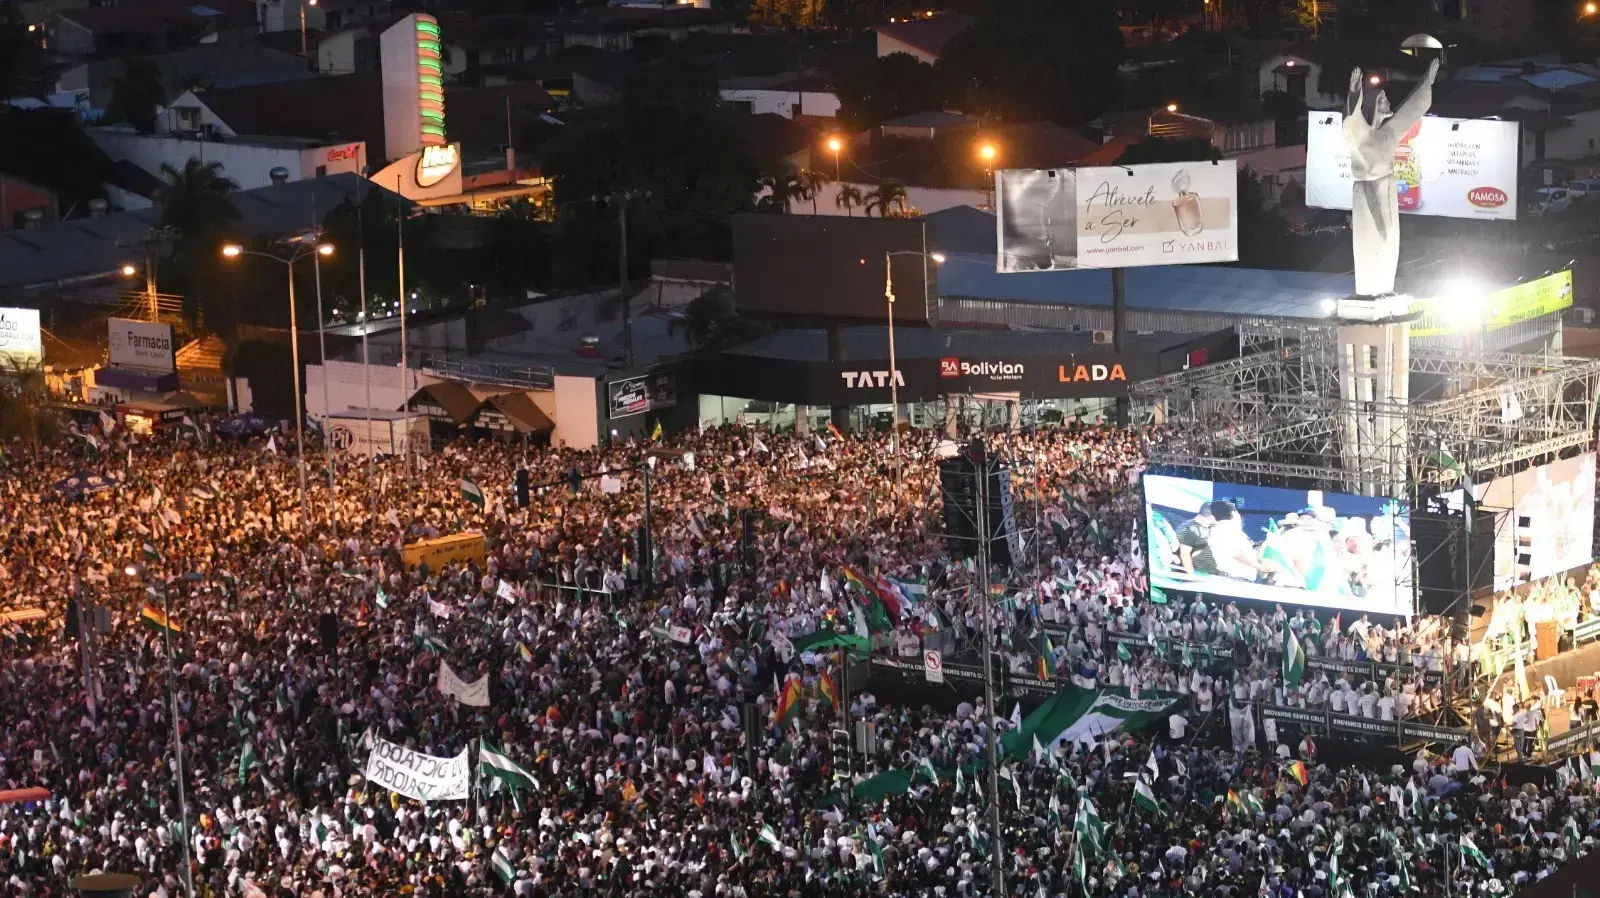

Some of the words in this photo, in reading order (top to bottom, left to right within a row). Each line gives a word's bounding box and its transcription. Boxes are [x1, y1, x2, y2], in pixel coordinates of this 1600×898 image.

[1470, 191, 1505, 203] FAMOSA
[1085, 221, 1095, 231] a
[1100, 209, 1139, 243] Ser
[1086, 246, 1144, 254] www.yanbal.com
[1179, 240, 1230, 252] YANBAL
[127, 330, 170, 350] Farmacia
[960, 361, 1024, 375] Bolivian
[1058, 363, 1127, 382] LADA
[841, 370, 906, 388] TATA
[1292, 712, 1310, 721] SANTA
[1311, 715, 1325, 723] CRUZ
[1362, 722, 1380, 731] SANTA
[1381, 725, 1396, 733] CRUZ
[1435, 732, 1453, 740] SANTA
